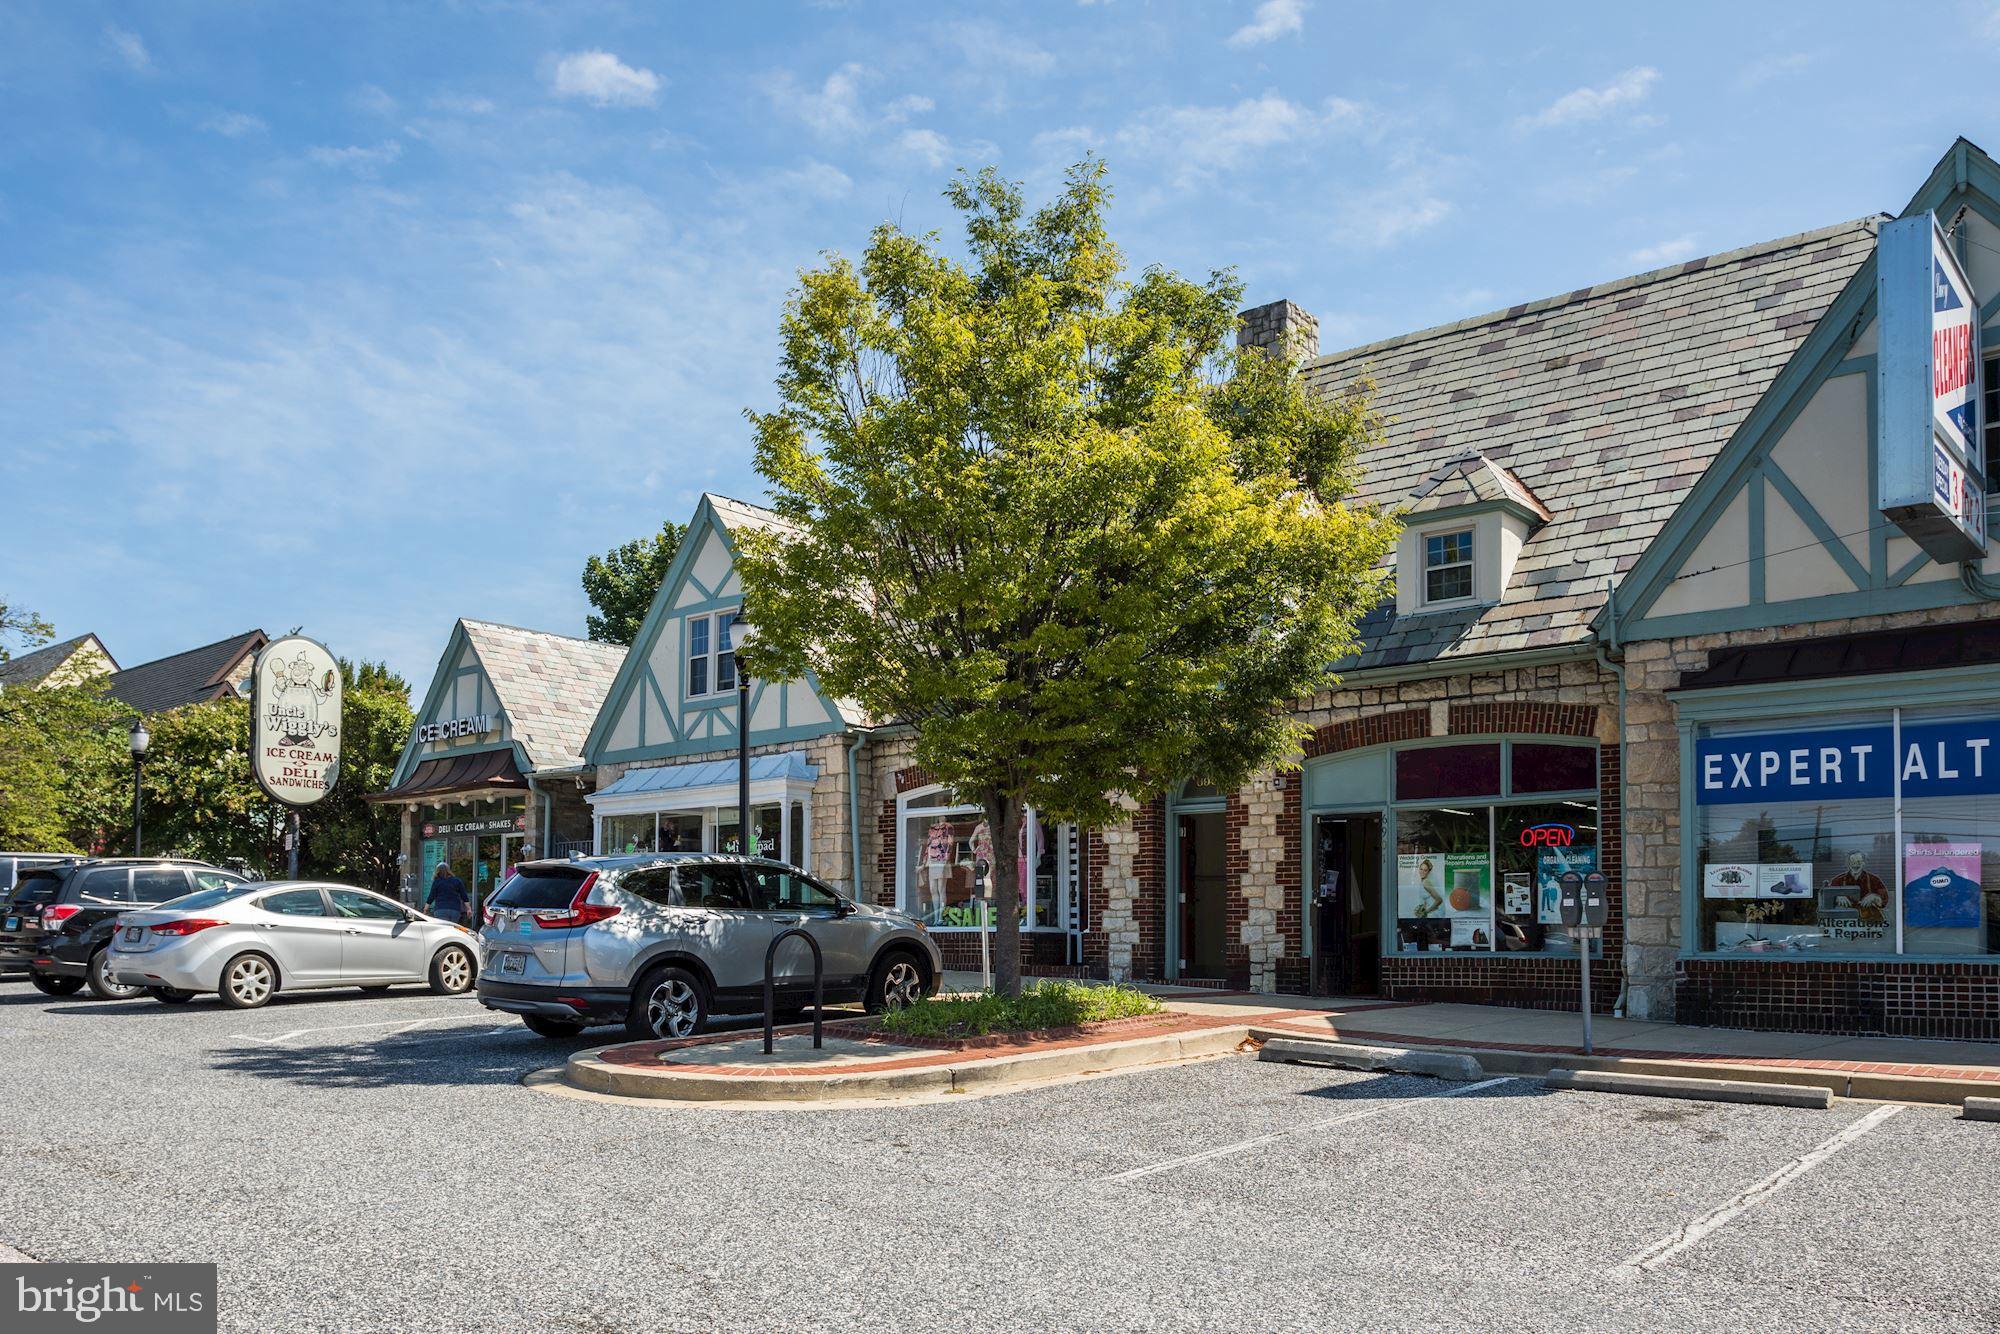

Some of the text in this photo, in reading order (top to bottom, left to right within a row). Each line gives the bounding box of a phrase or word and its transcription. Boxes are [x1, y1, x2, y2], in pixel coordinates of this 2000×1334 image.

[1933, 321, 1976, 400] CLEANERS
[1952, 470, 1959, 511] 3
[1975, 496, 1982, 536] 2
[267, 702, 305, 719] Uncle
[262, 714, 338, 739] Wiggly's
[415, 714, 487, 744] ICE CREAM
[266, 747, 287, 758] ICE
[282, 766, 318, 779] DELI
[1703, 738, 1991, 790] EXPERT ALT
[268, 776, 331, 790] SANDWICHES
[438, 825, 451, 834] DELI
[454, 823, 464, 832] ICE
[464, 822, 485, 831] CREAM
[488, 819, 511, 829] SHAKES
[1520, 828, 1572, 847] OPEN
[1908, 848, 1933, 856] Shirts
[948, 906, 998, 926] SALE
[1817, 917, 1890, 928] Alterations
[1834, 928, 1883, 941] Repairs
